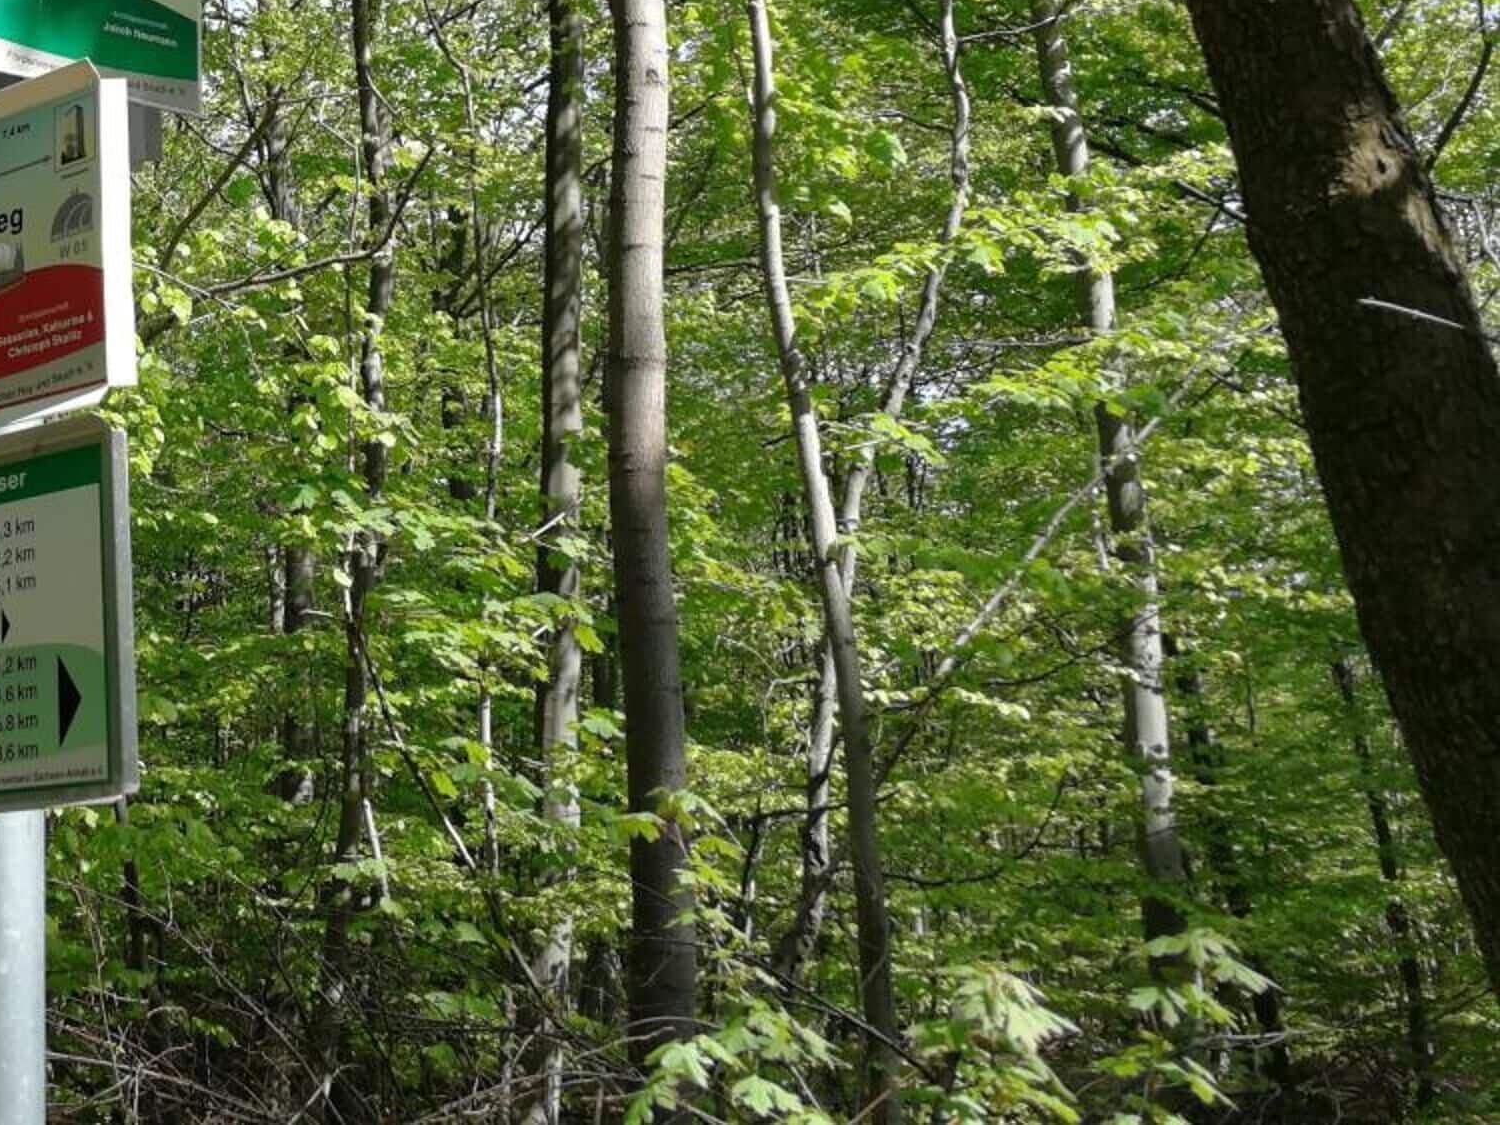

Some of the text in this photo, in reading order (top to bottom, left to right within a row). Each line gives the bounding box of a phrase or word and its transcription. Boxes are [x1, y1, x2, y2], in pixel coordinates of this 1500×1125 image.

[14, 517, 35, 537] km
[14, 546, 35, 564] km
[15, 574, 37, 591] km
[16, 654, 37, 671] km
[16, 683, 38, 700] km
[17, 712, 38, 729] km
[17, 742, 39, 759] km
